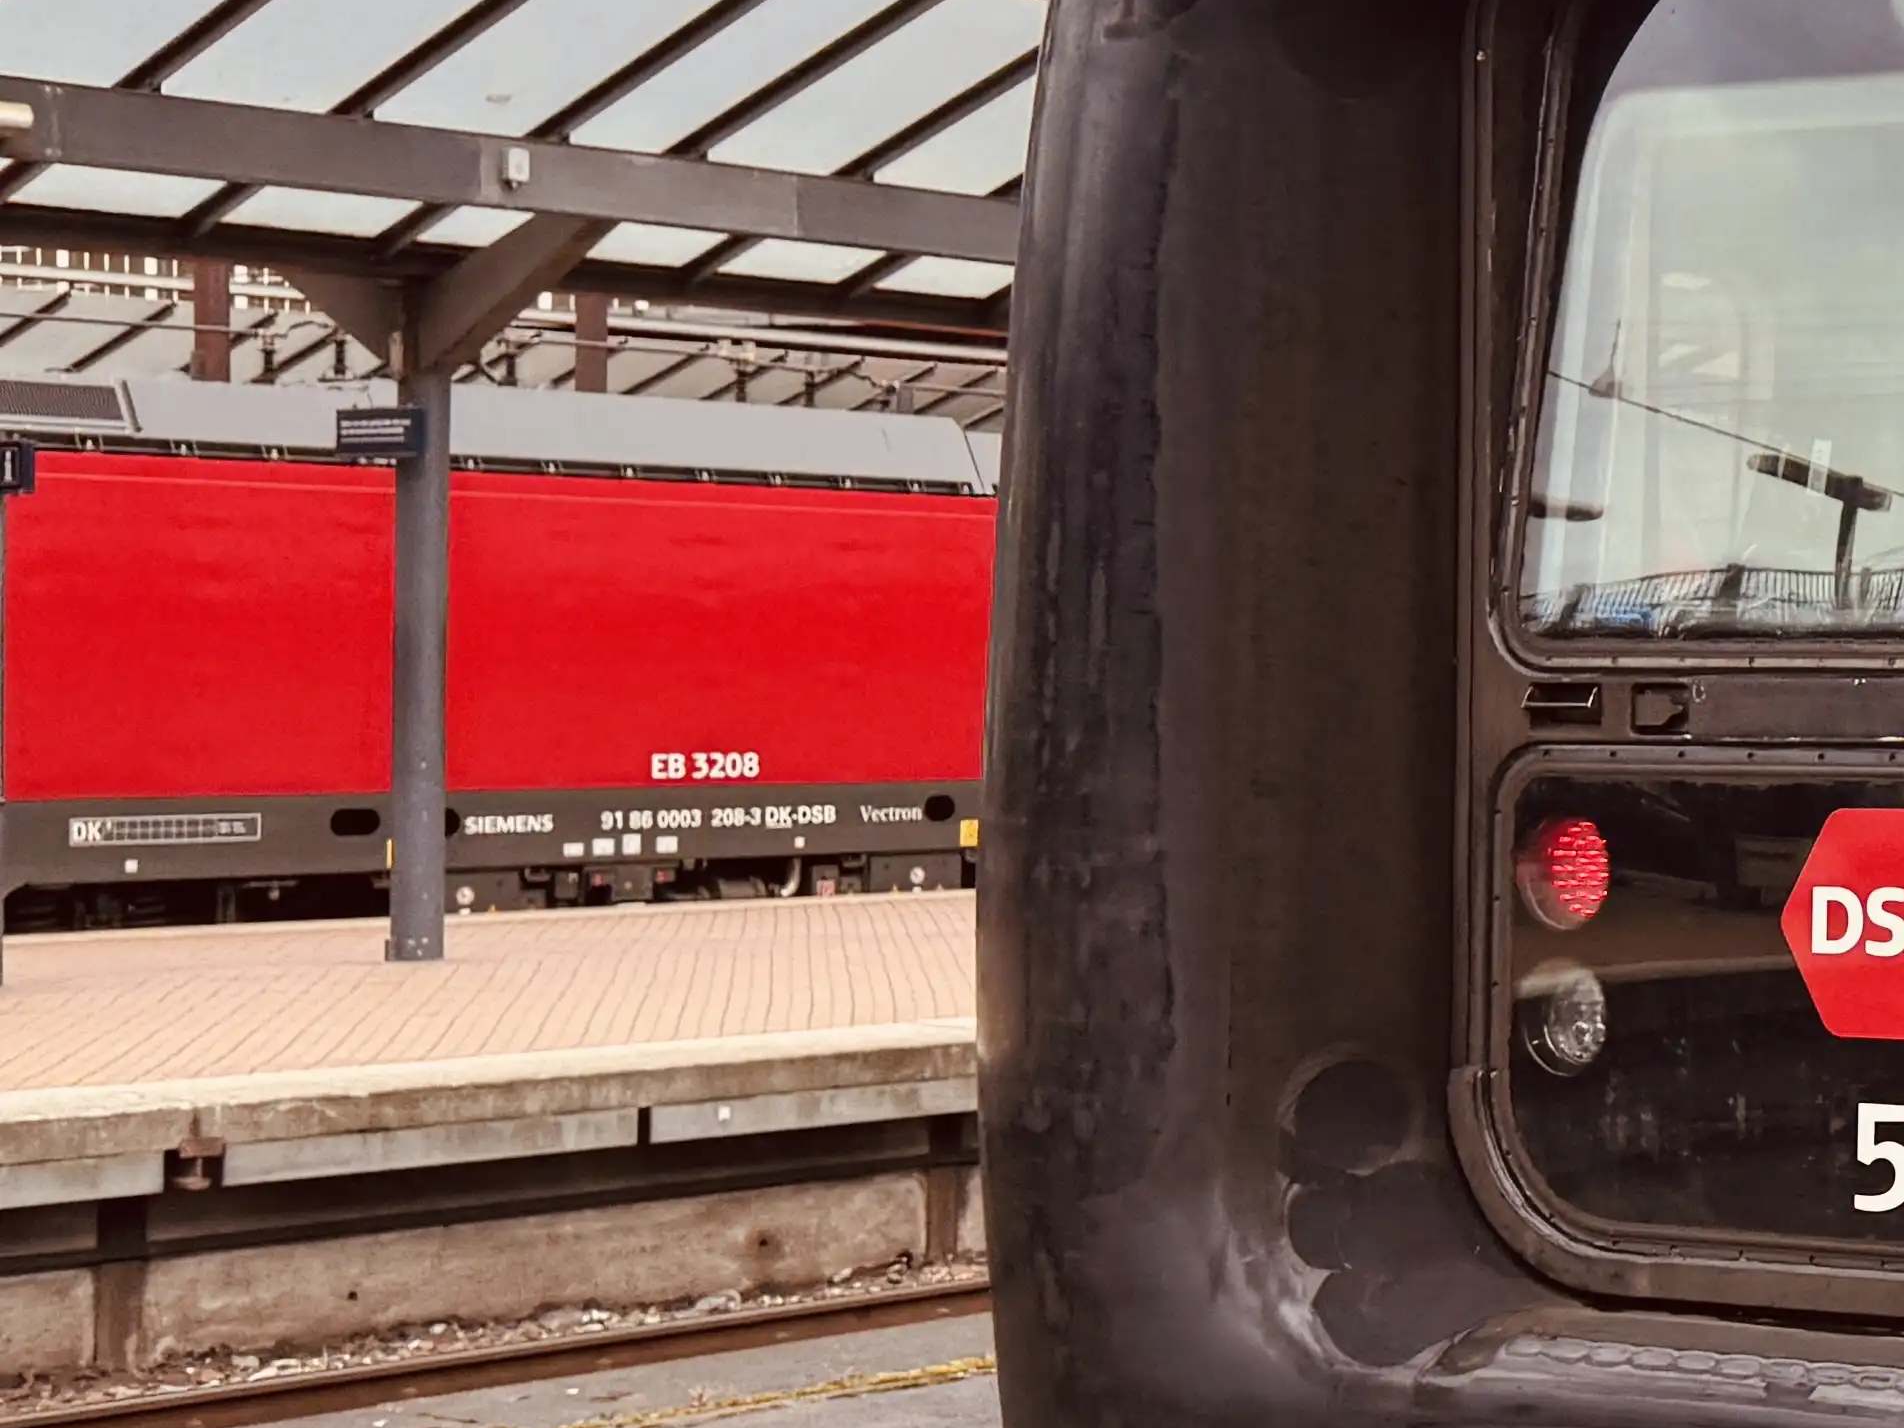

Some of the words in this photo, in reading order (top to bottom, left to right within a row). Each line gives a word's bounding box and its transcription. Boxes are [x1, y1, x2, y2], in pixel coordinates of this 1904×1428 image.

[651, 752, 687, 780] EB
[690, 751, 760, 779] 3208
[464, 814, 554, 835] SIEMENS
[600, 810, 624, 831] 91
[656, 808, 702, 829] 0003
[711, 806, 762, 828] 208-3
[765, 804, 837, 830] DK-DSB
[859, 804, 923, 823] Vectron
[72, 821, 101, 843] DK
